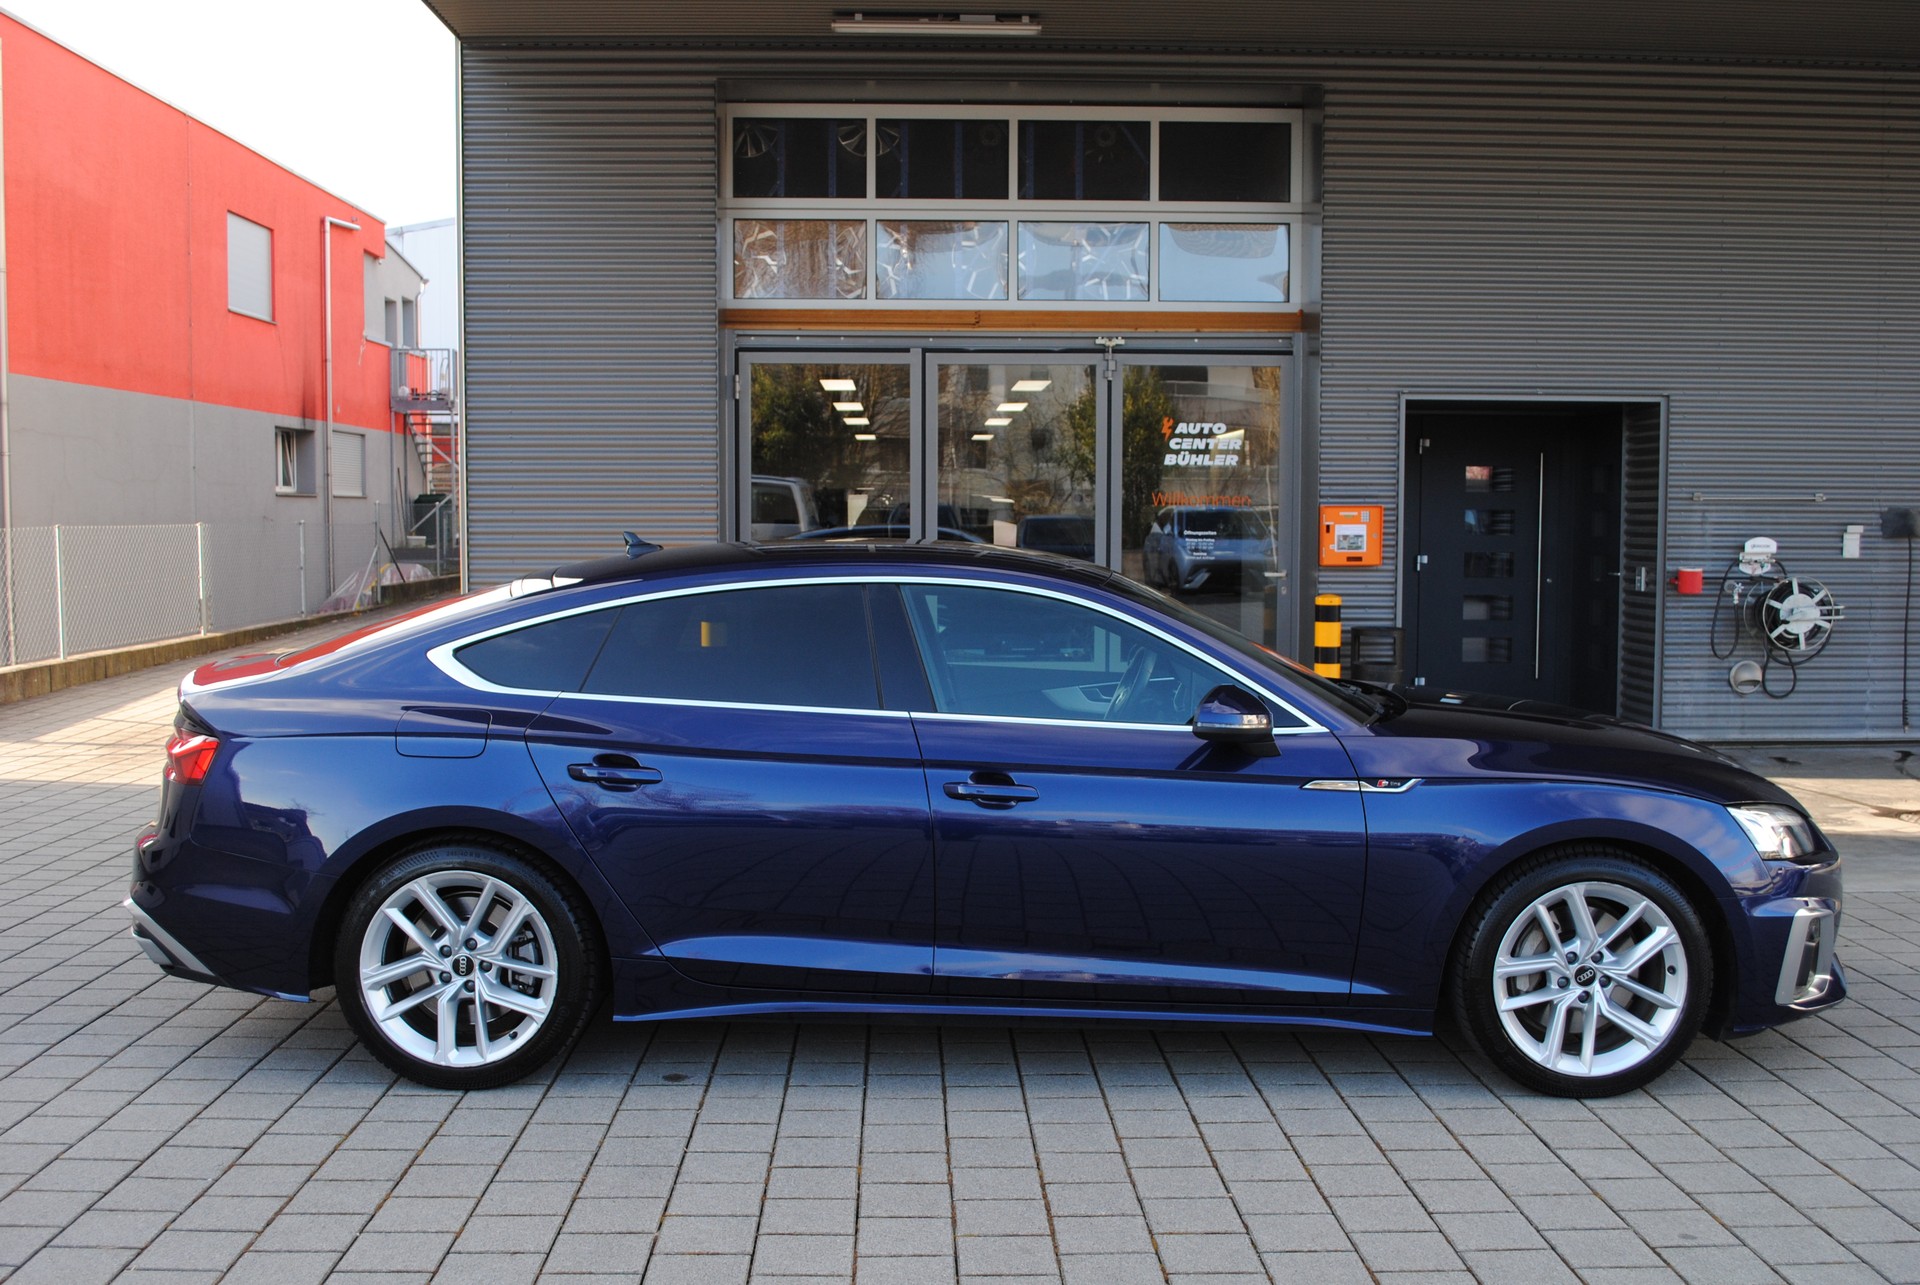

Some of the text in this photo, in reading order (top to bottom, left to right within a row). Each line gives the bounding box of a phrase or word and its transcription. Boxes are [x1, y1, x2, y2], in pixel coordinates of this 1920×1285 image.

[1174, 422, 1227, 434] AUTO
[1169, 437, 1242, 450] CENTER
[1163, 451, 1239, 466] BÜHLER
[1151, 491, 1252, 507] Willkommen
